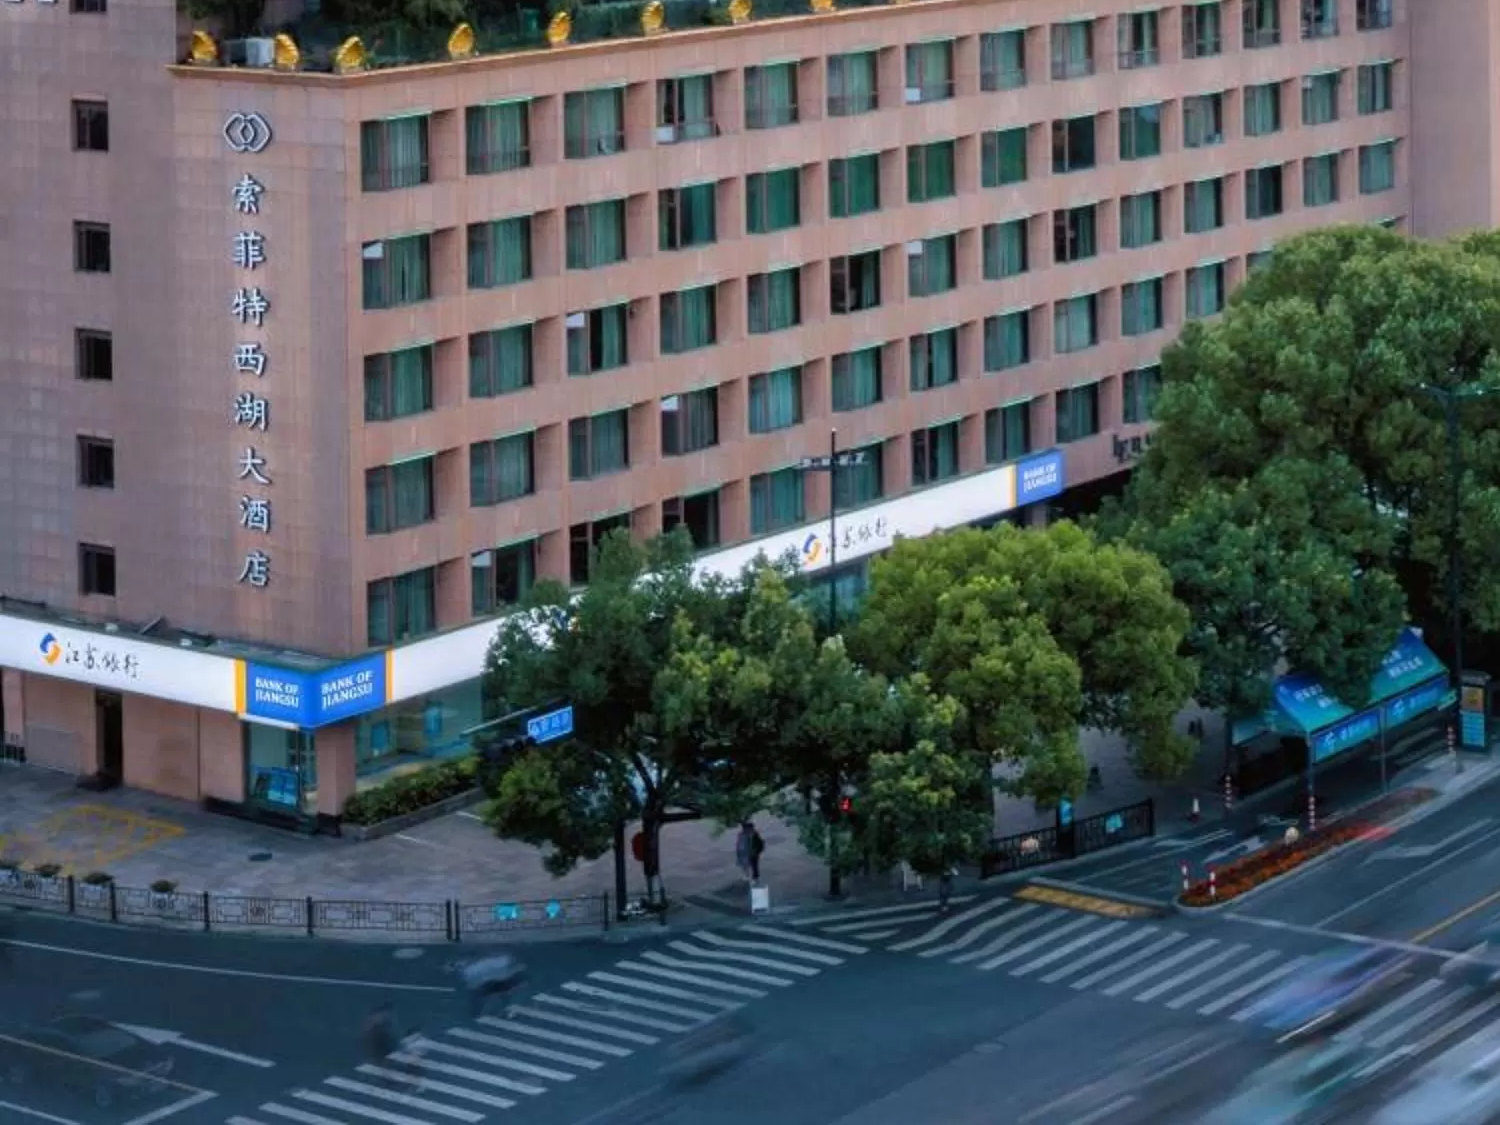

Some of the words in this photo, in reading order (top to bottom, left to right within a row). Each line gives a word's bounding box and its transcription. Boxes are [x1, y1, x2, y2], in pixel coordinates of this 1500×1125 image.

[231, 173, 272, 587] 索菲特西湖大酒店
[255, 676, 283, 690] BANK
[285, 682, 299, 695] OF
[321, 676, 355, 695] BANK
[356, 670, 373, 684] OF
[255, 689, 299, 708] JIANGSU
[322, 683, 373, 711] JIANGSU
